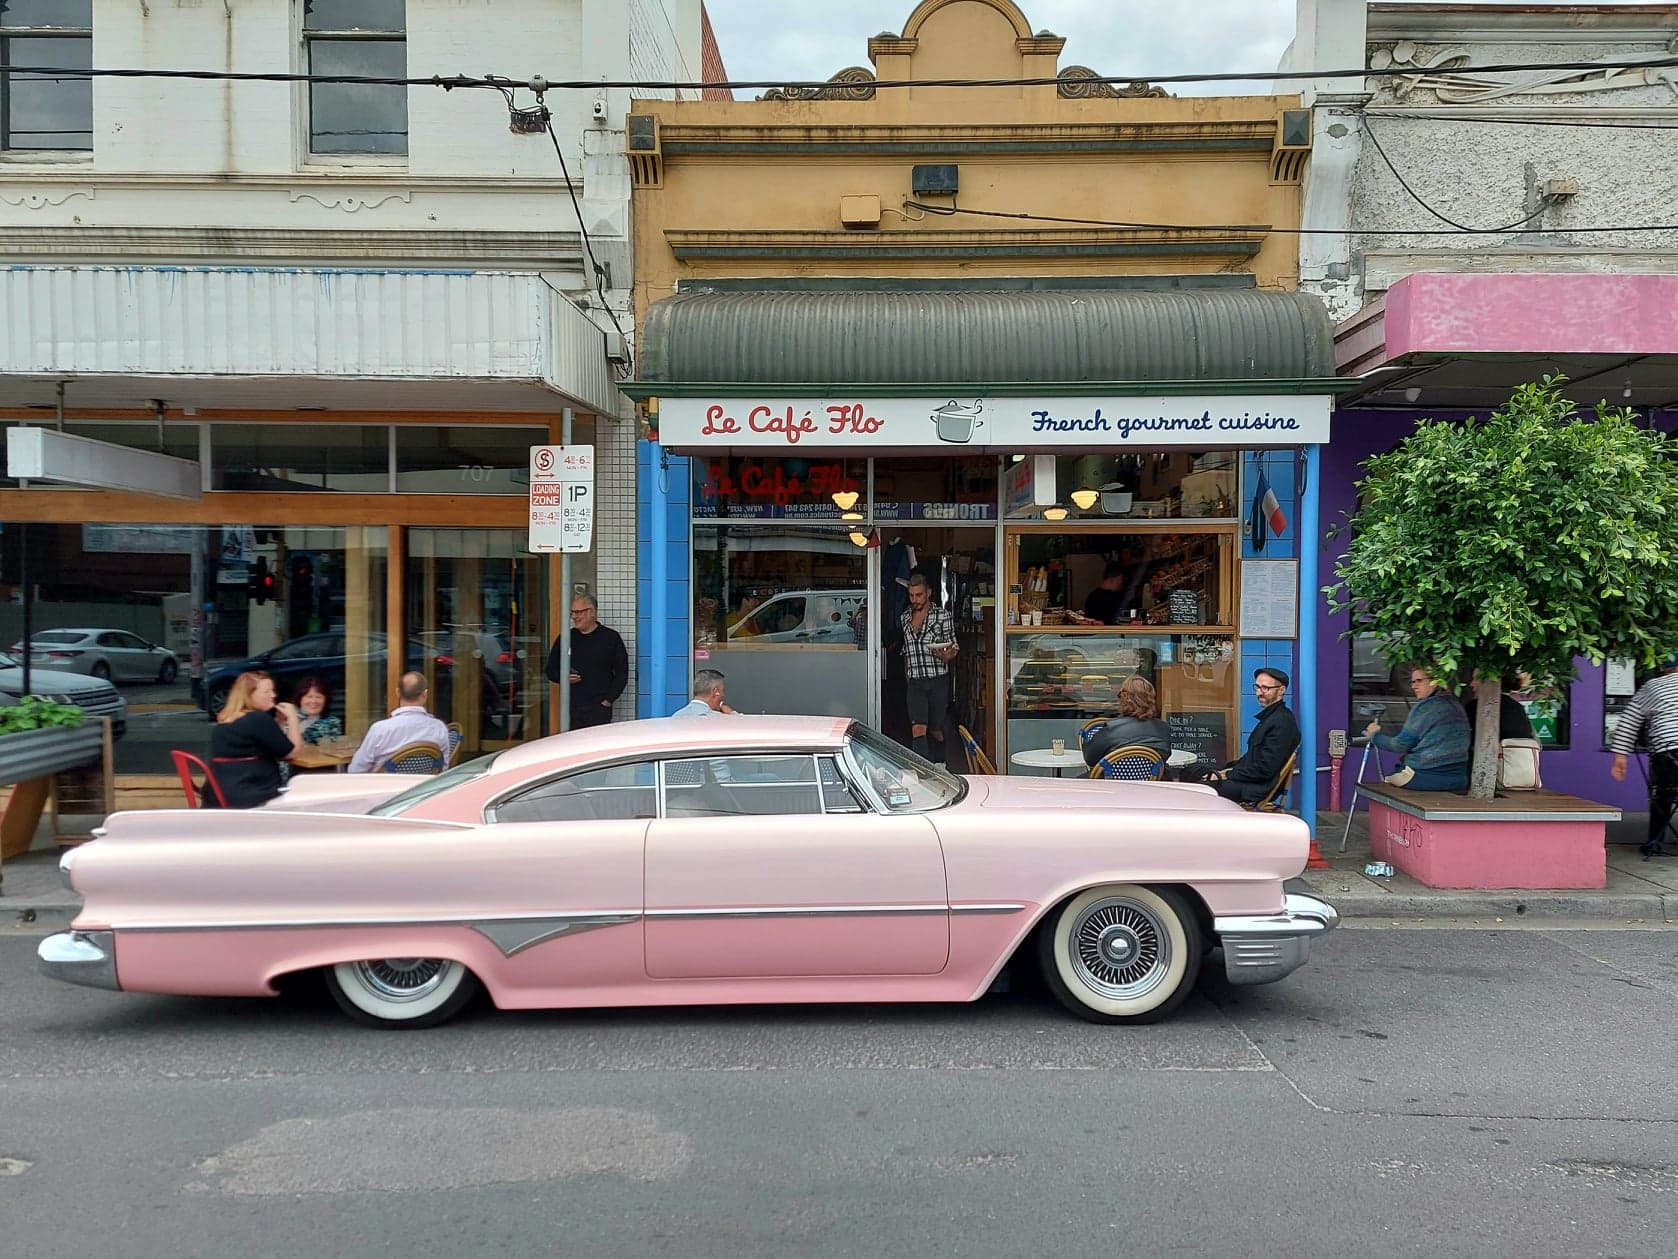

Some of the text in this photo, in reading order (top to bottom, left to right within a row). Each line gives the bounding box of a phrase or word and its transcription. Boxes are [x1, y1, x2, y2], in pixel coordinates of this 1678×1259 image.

[702, 404, 884, 443] Le Café Flo
[1031, 409, 1300, 438] French gourmet cuisine
[457, 465, 494, 481] 707
[532, 485, 560, 495] LOADING
[568, 485, 588, 502] 1P
[532, 495, 560, 505] ZONE
